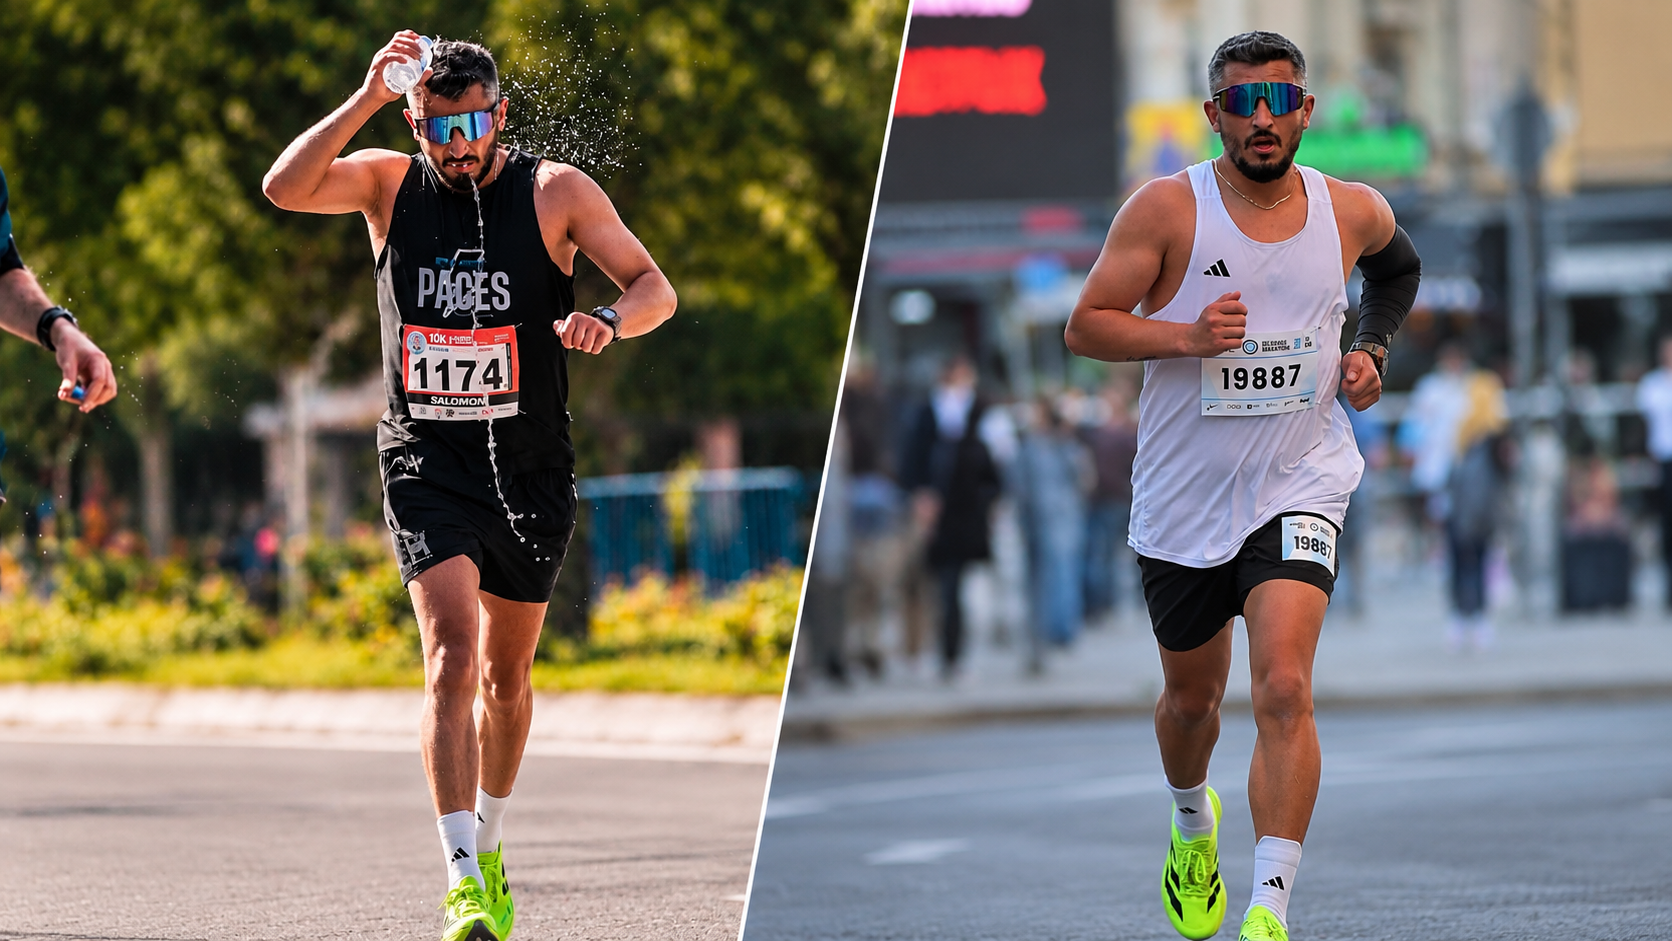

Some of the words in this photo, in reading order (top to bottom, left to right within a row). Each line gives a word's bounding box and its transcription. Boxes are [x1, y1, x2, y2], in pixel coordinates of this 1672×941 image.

[417, 267, 511, 311] PACES
[429, 333, 447, 344] 10K
[414, 357, 503, 392] 1174
[1221, 364, 1301, 390] 19887
[430, 396, 486, 406] SALOMON
[1294, 535, 1332, 559] 19887
